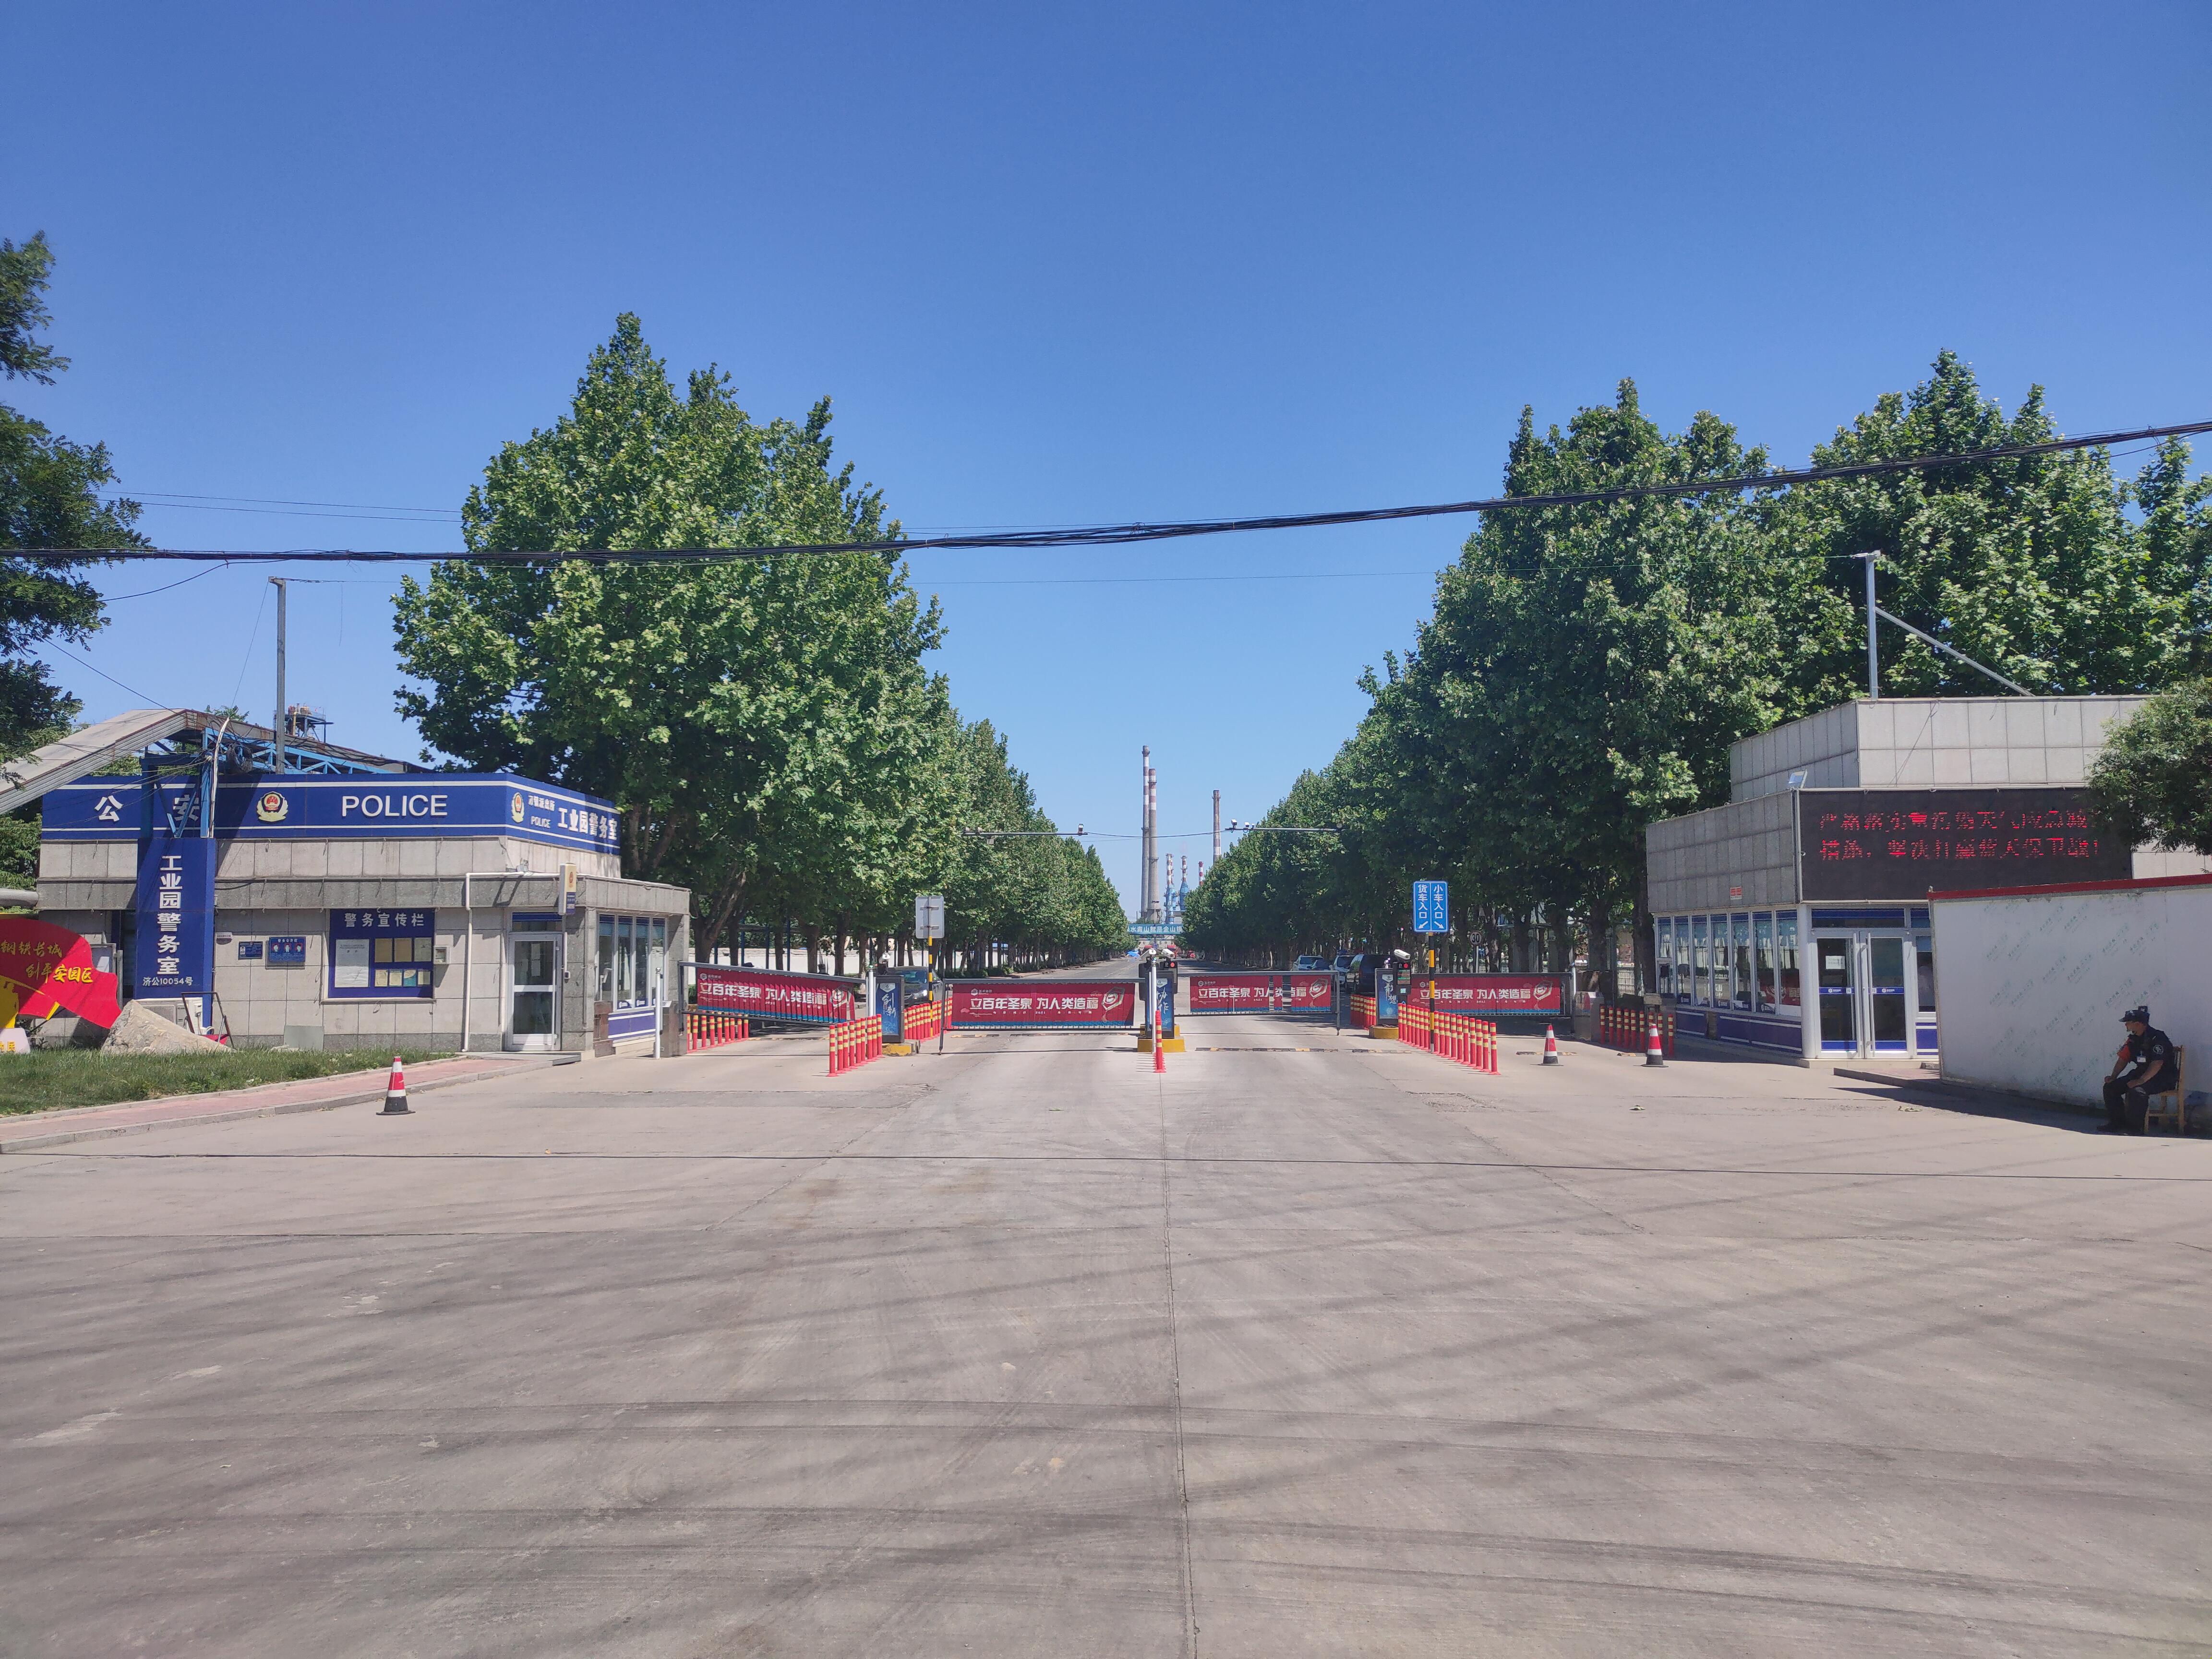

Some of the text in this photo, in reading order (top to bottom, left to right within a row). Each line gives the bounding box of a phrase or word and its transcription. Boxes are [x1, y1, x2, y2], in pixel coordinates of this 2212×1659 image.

[342, 795, 448, 817] POLICE
[531, 816, 551, 829] POLICE
[558, 807, 617, 840] 工业园警务室
[1418, 884, 1429, 919] 货车入口
[1433, 884, 1444, 919] 小车入口
[157, 855, 183, 974] 工业园警务室
[345, 913, 424, 927] 警务宣传栏
[1472, 934, 1480, 943] 30
[143, 976, 193, 986] 济公10054号
[699, 982, 761, 999] 立百年圣泉
[1198, 987, 1250, 998] 立百年圣泉
[1420, 988, 1530, 999] 立百年圣泉 为人类造福
[970, 997, 1099, 1010] 立百年圣泉 为人类造福
